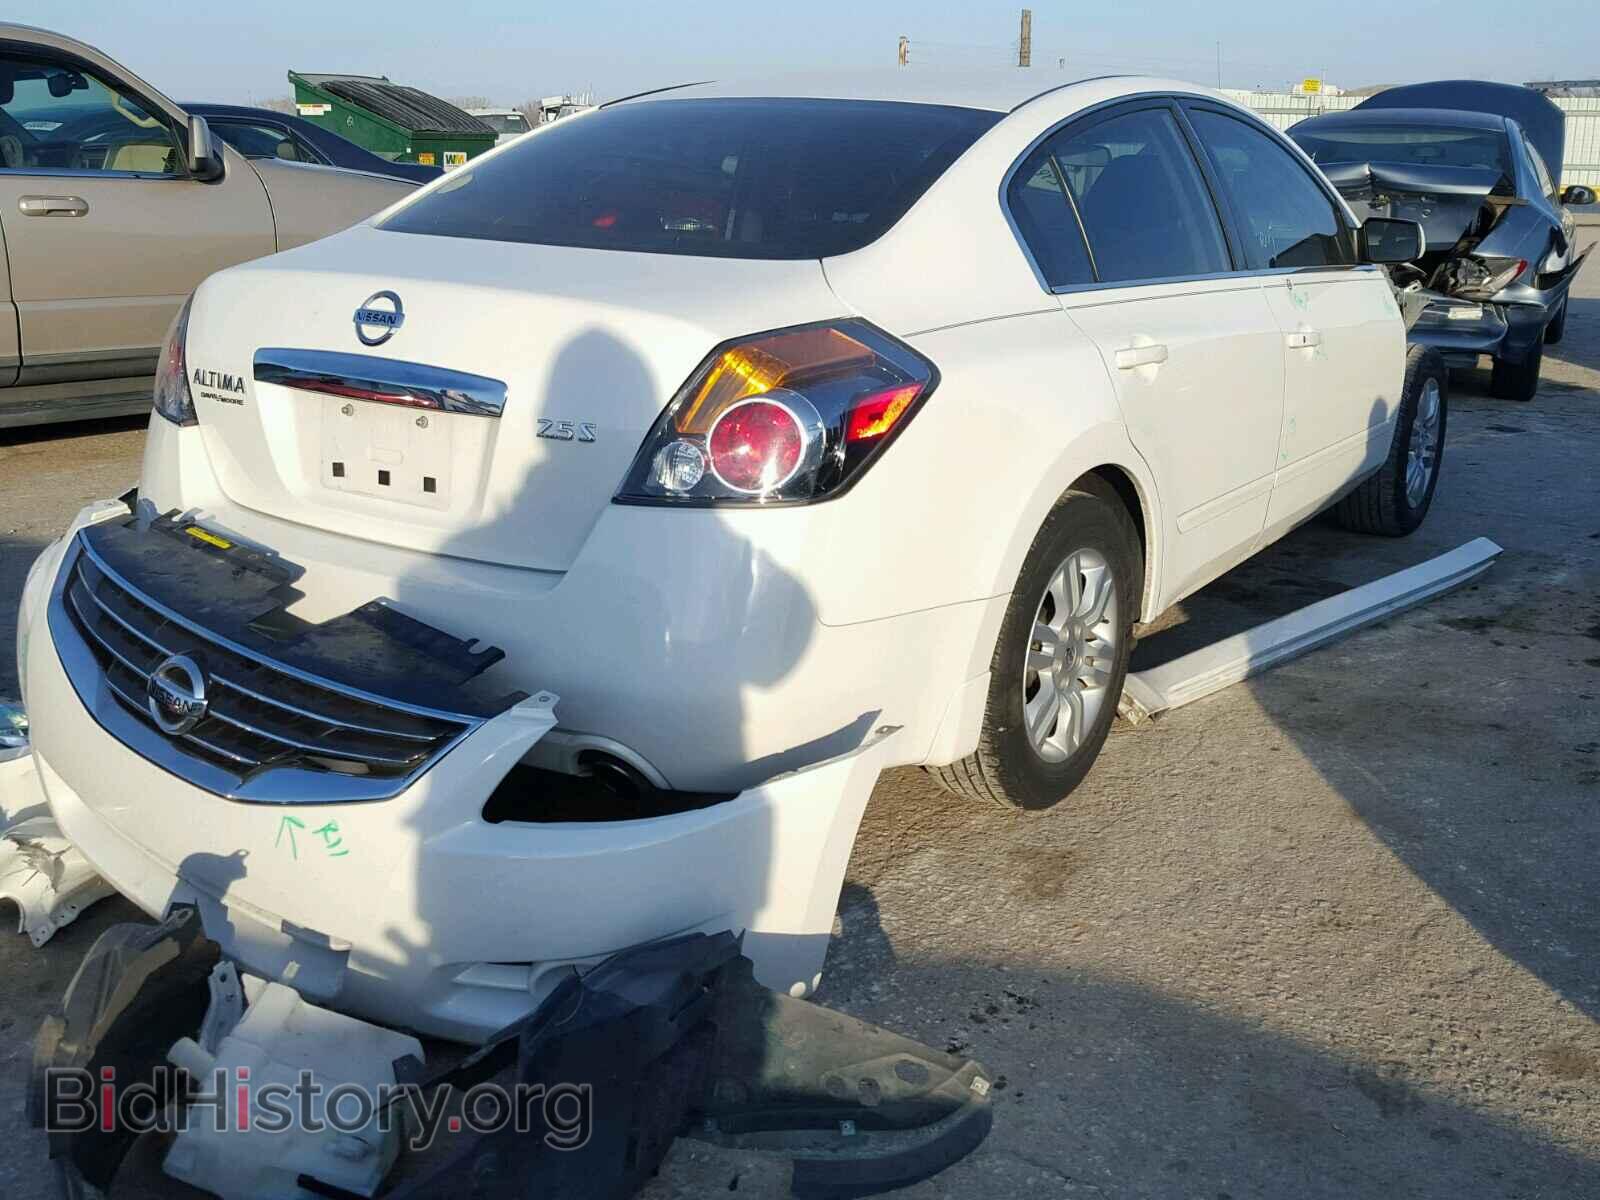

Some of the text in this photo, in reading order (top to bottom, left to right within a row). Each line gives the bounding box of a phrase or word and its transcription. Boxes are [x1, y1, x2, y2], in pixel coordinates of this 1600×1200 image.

[356, 310, 397, 325] NISSAN
[193, 368, 245, 393] ALTIMA
[578, 422, 597, 443] S
[149, 679, 196, 715] NISSAN
